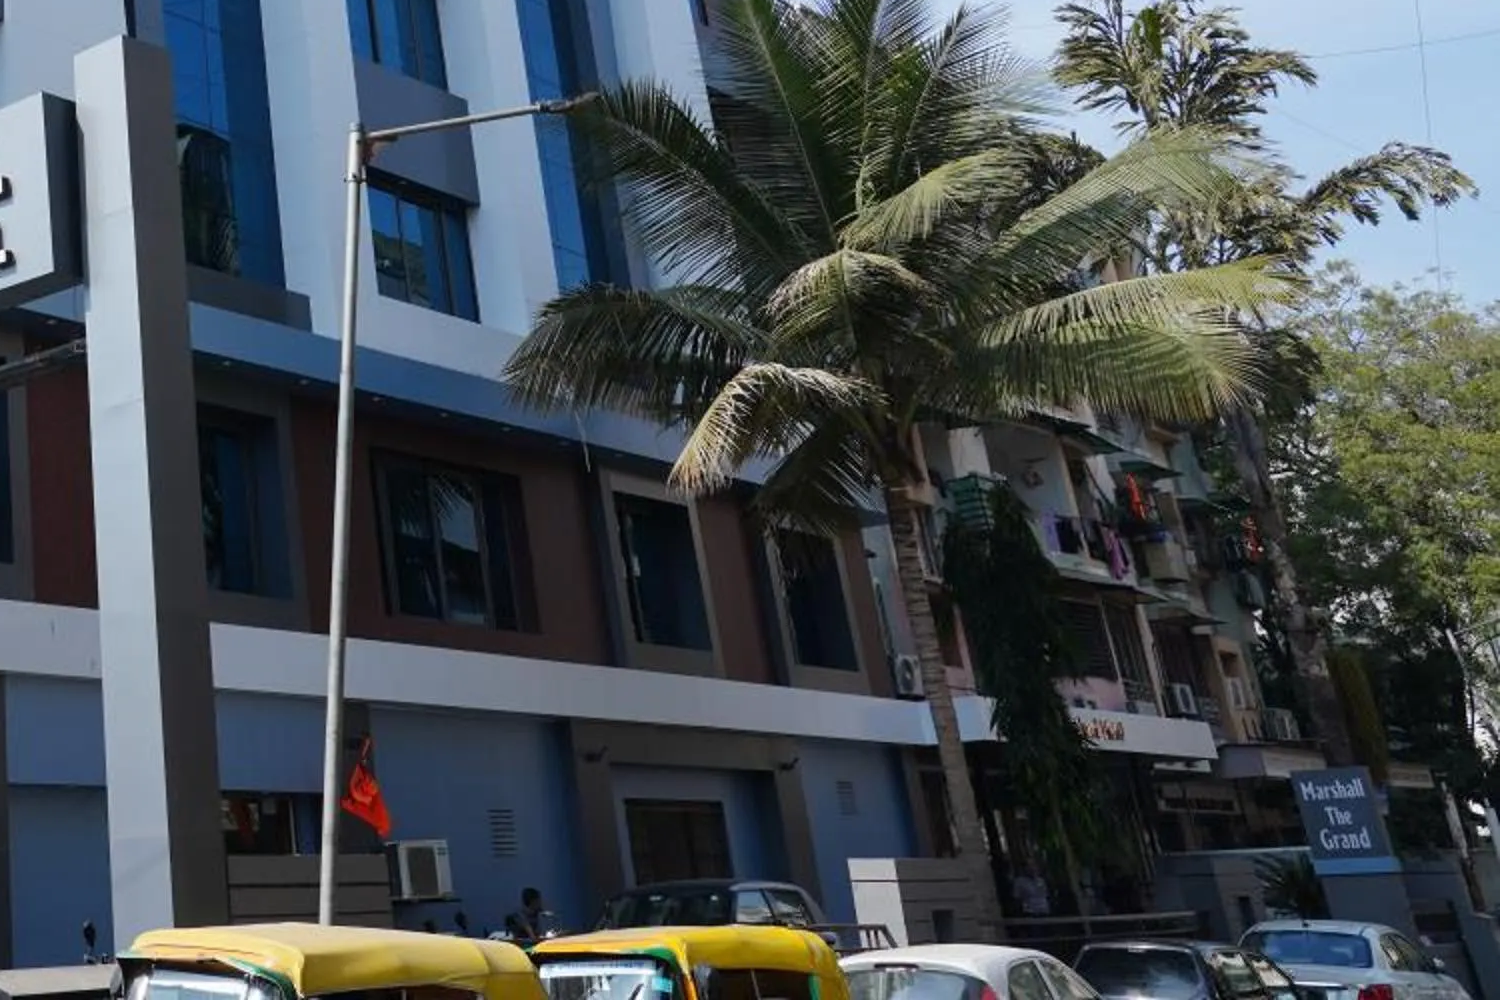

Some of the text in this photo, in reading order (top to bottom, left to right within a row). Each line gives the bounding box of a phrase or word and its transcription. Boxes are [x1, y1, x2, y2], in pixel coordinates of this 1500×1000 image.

[1300, 778, 1366, 801] Marshall
[1324, 806, 1353, 825] The
[1320, 826, 1371, 850] Grand
